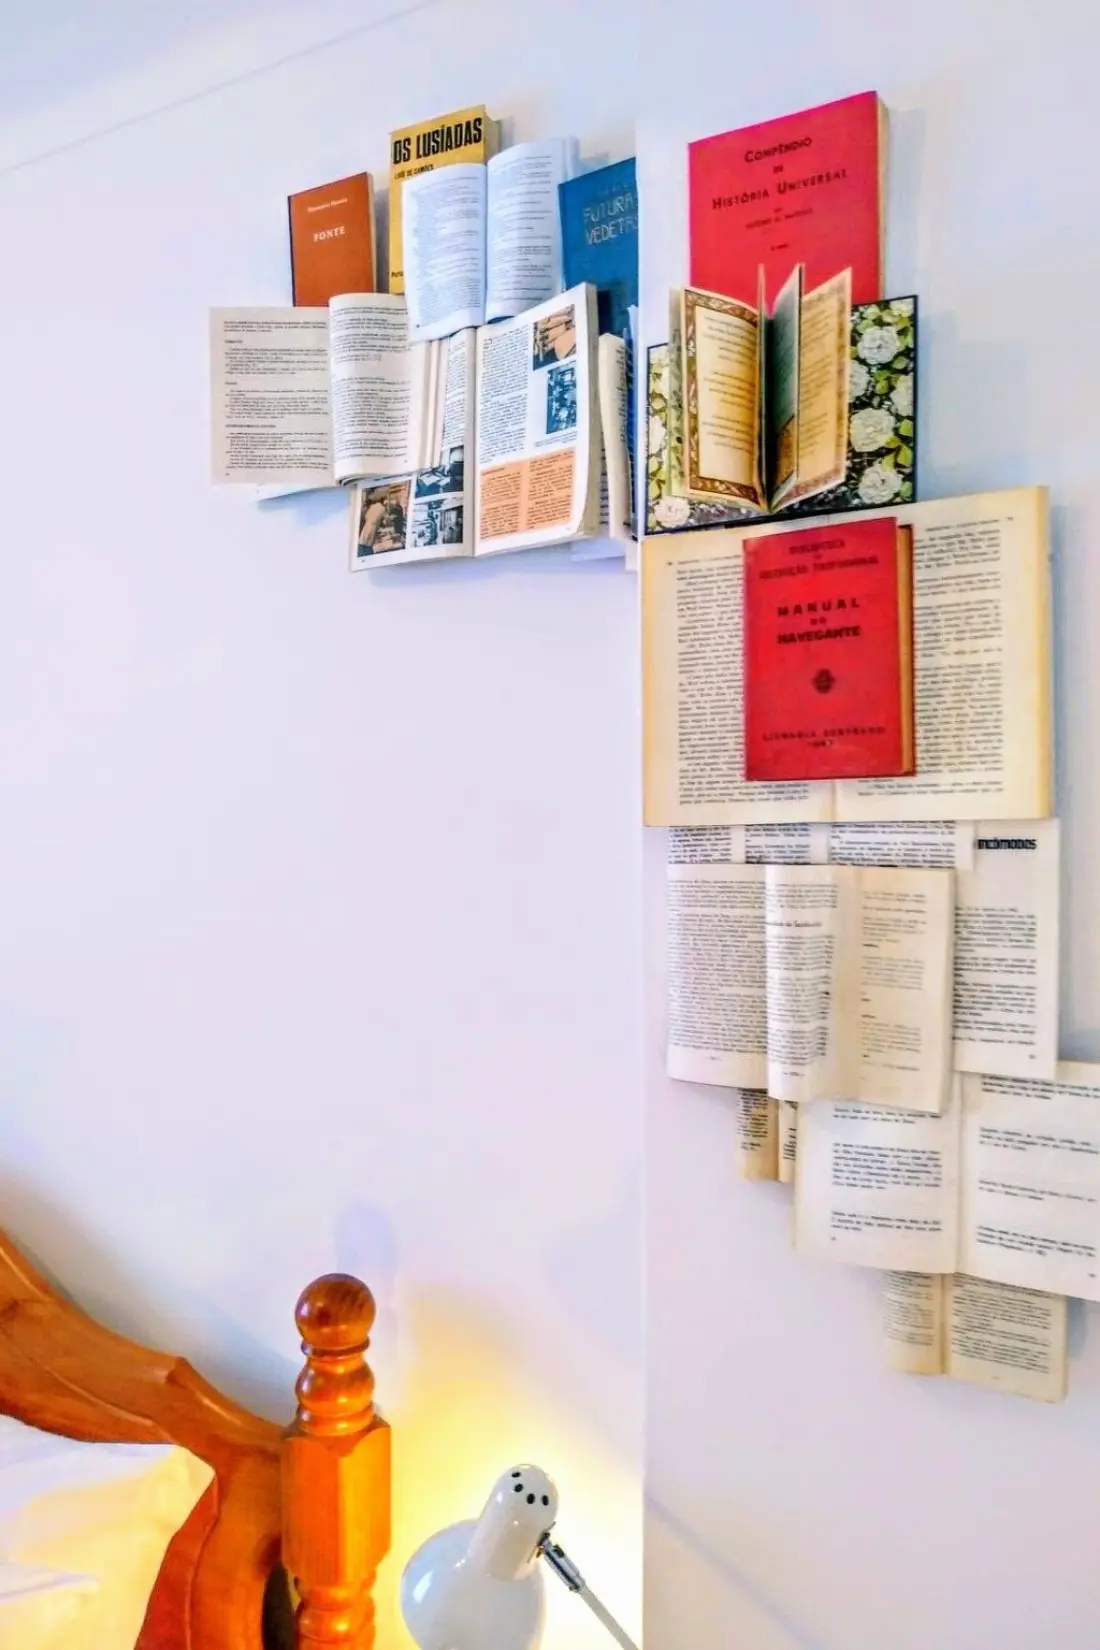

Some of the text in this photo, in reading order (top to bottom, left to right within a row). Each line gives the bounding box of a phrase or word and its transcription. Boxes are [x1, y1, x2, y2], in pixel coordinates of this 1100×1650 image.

[393, 117, 482, 165] OS LUSÍADAS
[777, 168, 847, 196] UNIVERSAL
[313, 226, 346, 243] FONTE
[777, 598, 860, 617] MANUAL
[777, 625, 861, 645] NAVEGANTE
